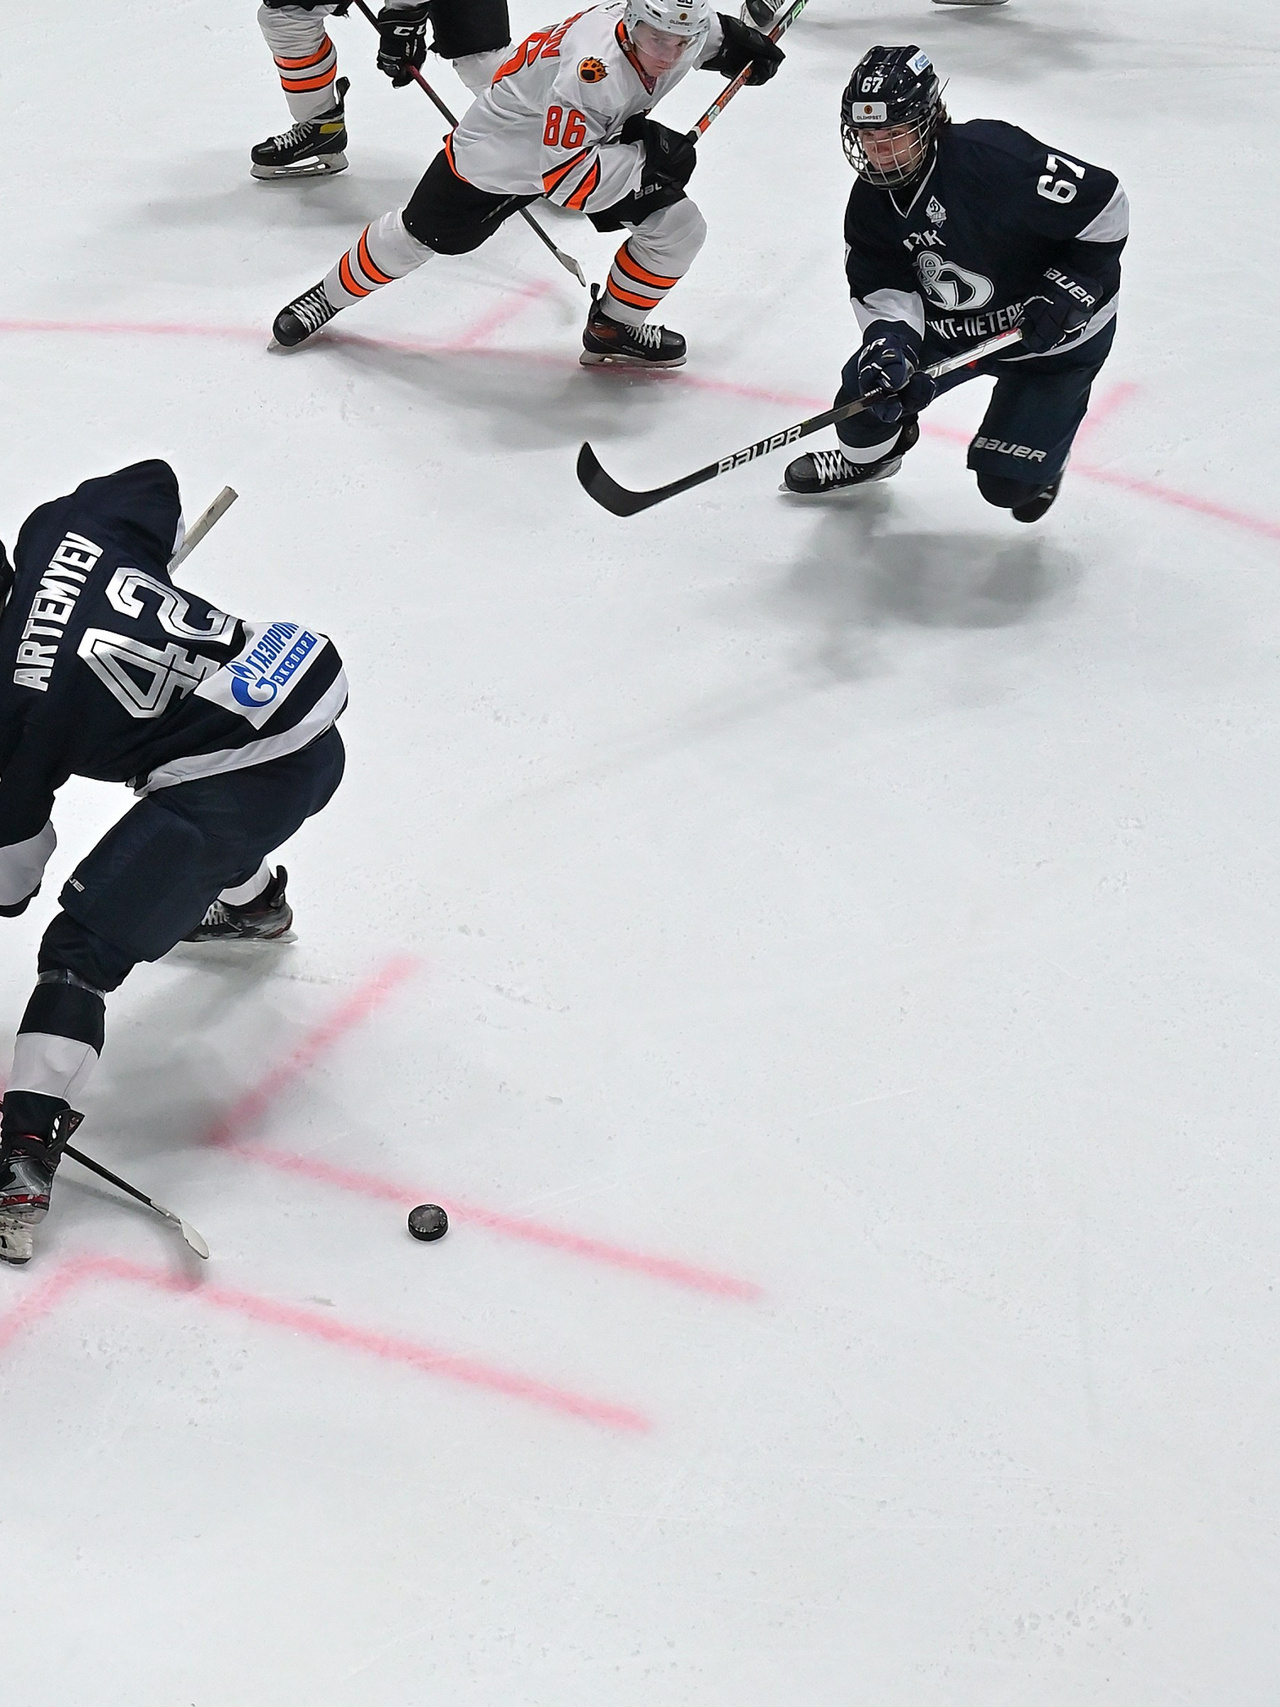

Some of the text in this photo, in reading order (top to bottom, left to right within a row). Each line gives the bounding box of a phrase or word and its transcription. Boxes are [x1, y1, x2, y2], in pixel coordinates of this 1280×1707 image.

[861, 76, 884, 93] 67
[543, 105, 587, 149] 86
[1036, 153, 1086, 204] 67
[974, 436, 1048, 463] BAUER
[13, 531, 104, 692] ARTEMYEV
[77, 566, 239, 718] 42
[274, 634, 314, 683] ЭКСПОРТ
